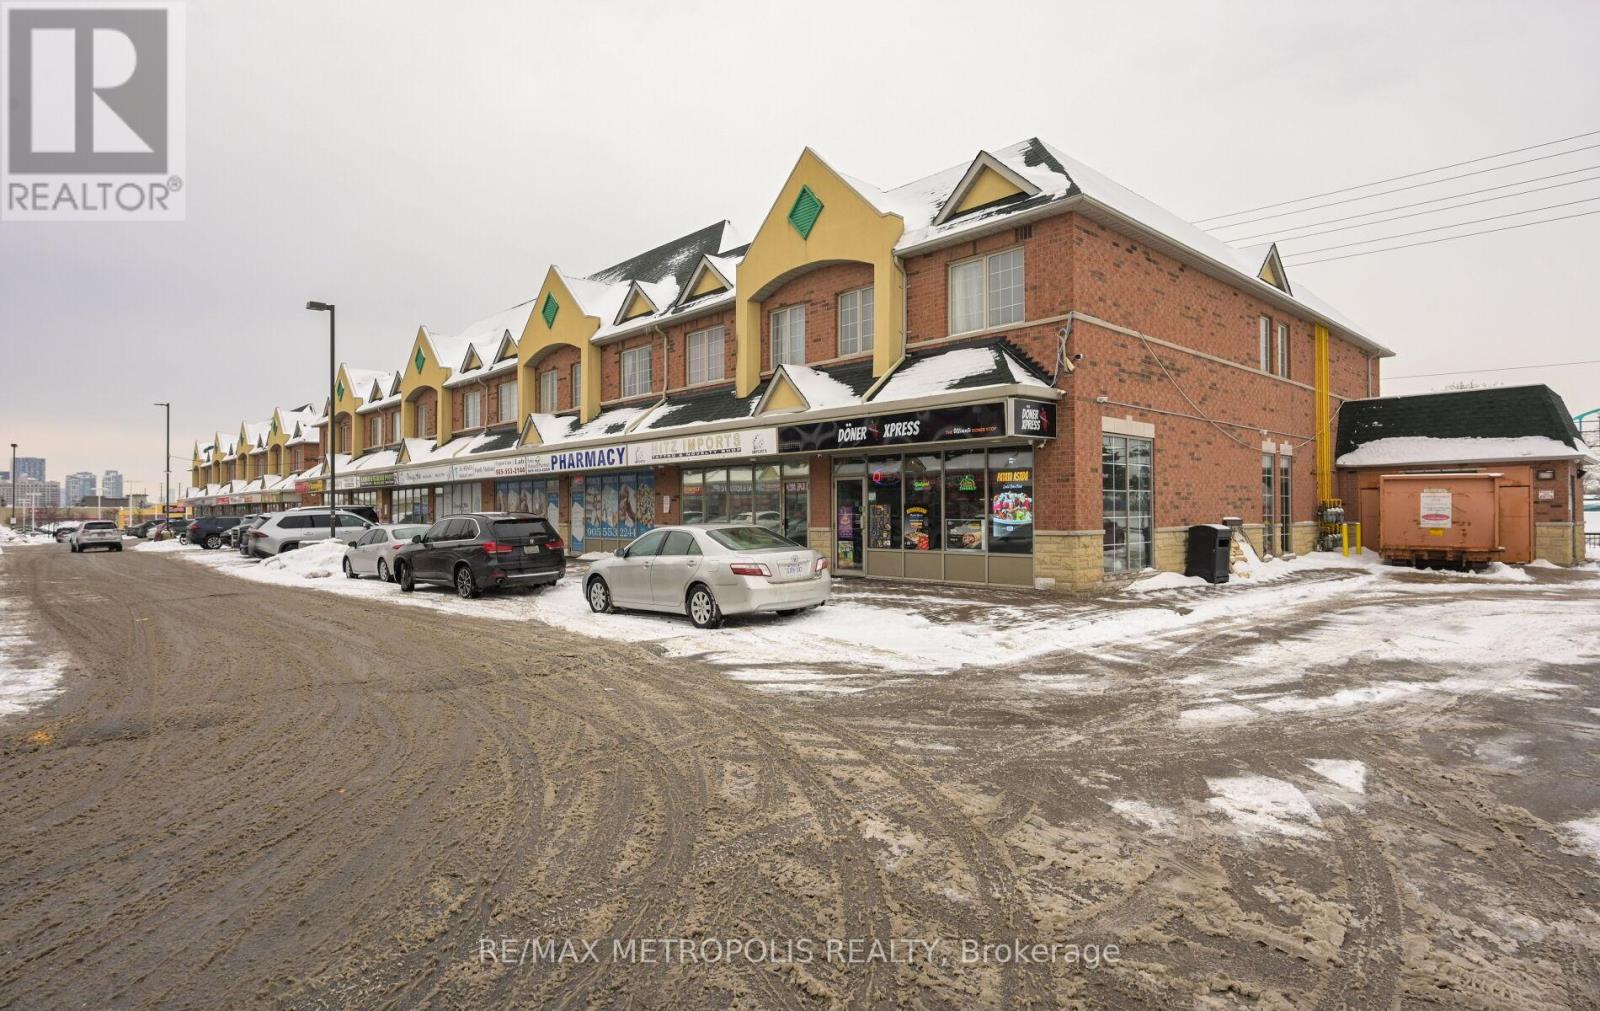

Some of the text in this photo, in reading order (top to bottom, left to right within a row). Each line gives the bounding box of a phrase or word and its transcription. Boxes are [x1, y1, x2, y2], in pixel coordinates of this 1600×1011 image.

[838, 420, 920, 442] DÖNER XPRESS
[1021, 419, 1041, 430] XPRESS
[683, 434, 740, 451] IMPORTS
[551, 446, 625, 471] PHARMACY
